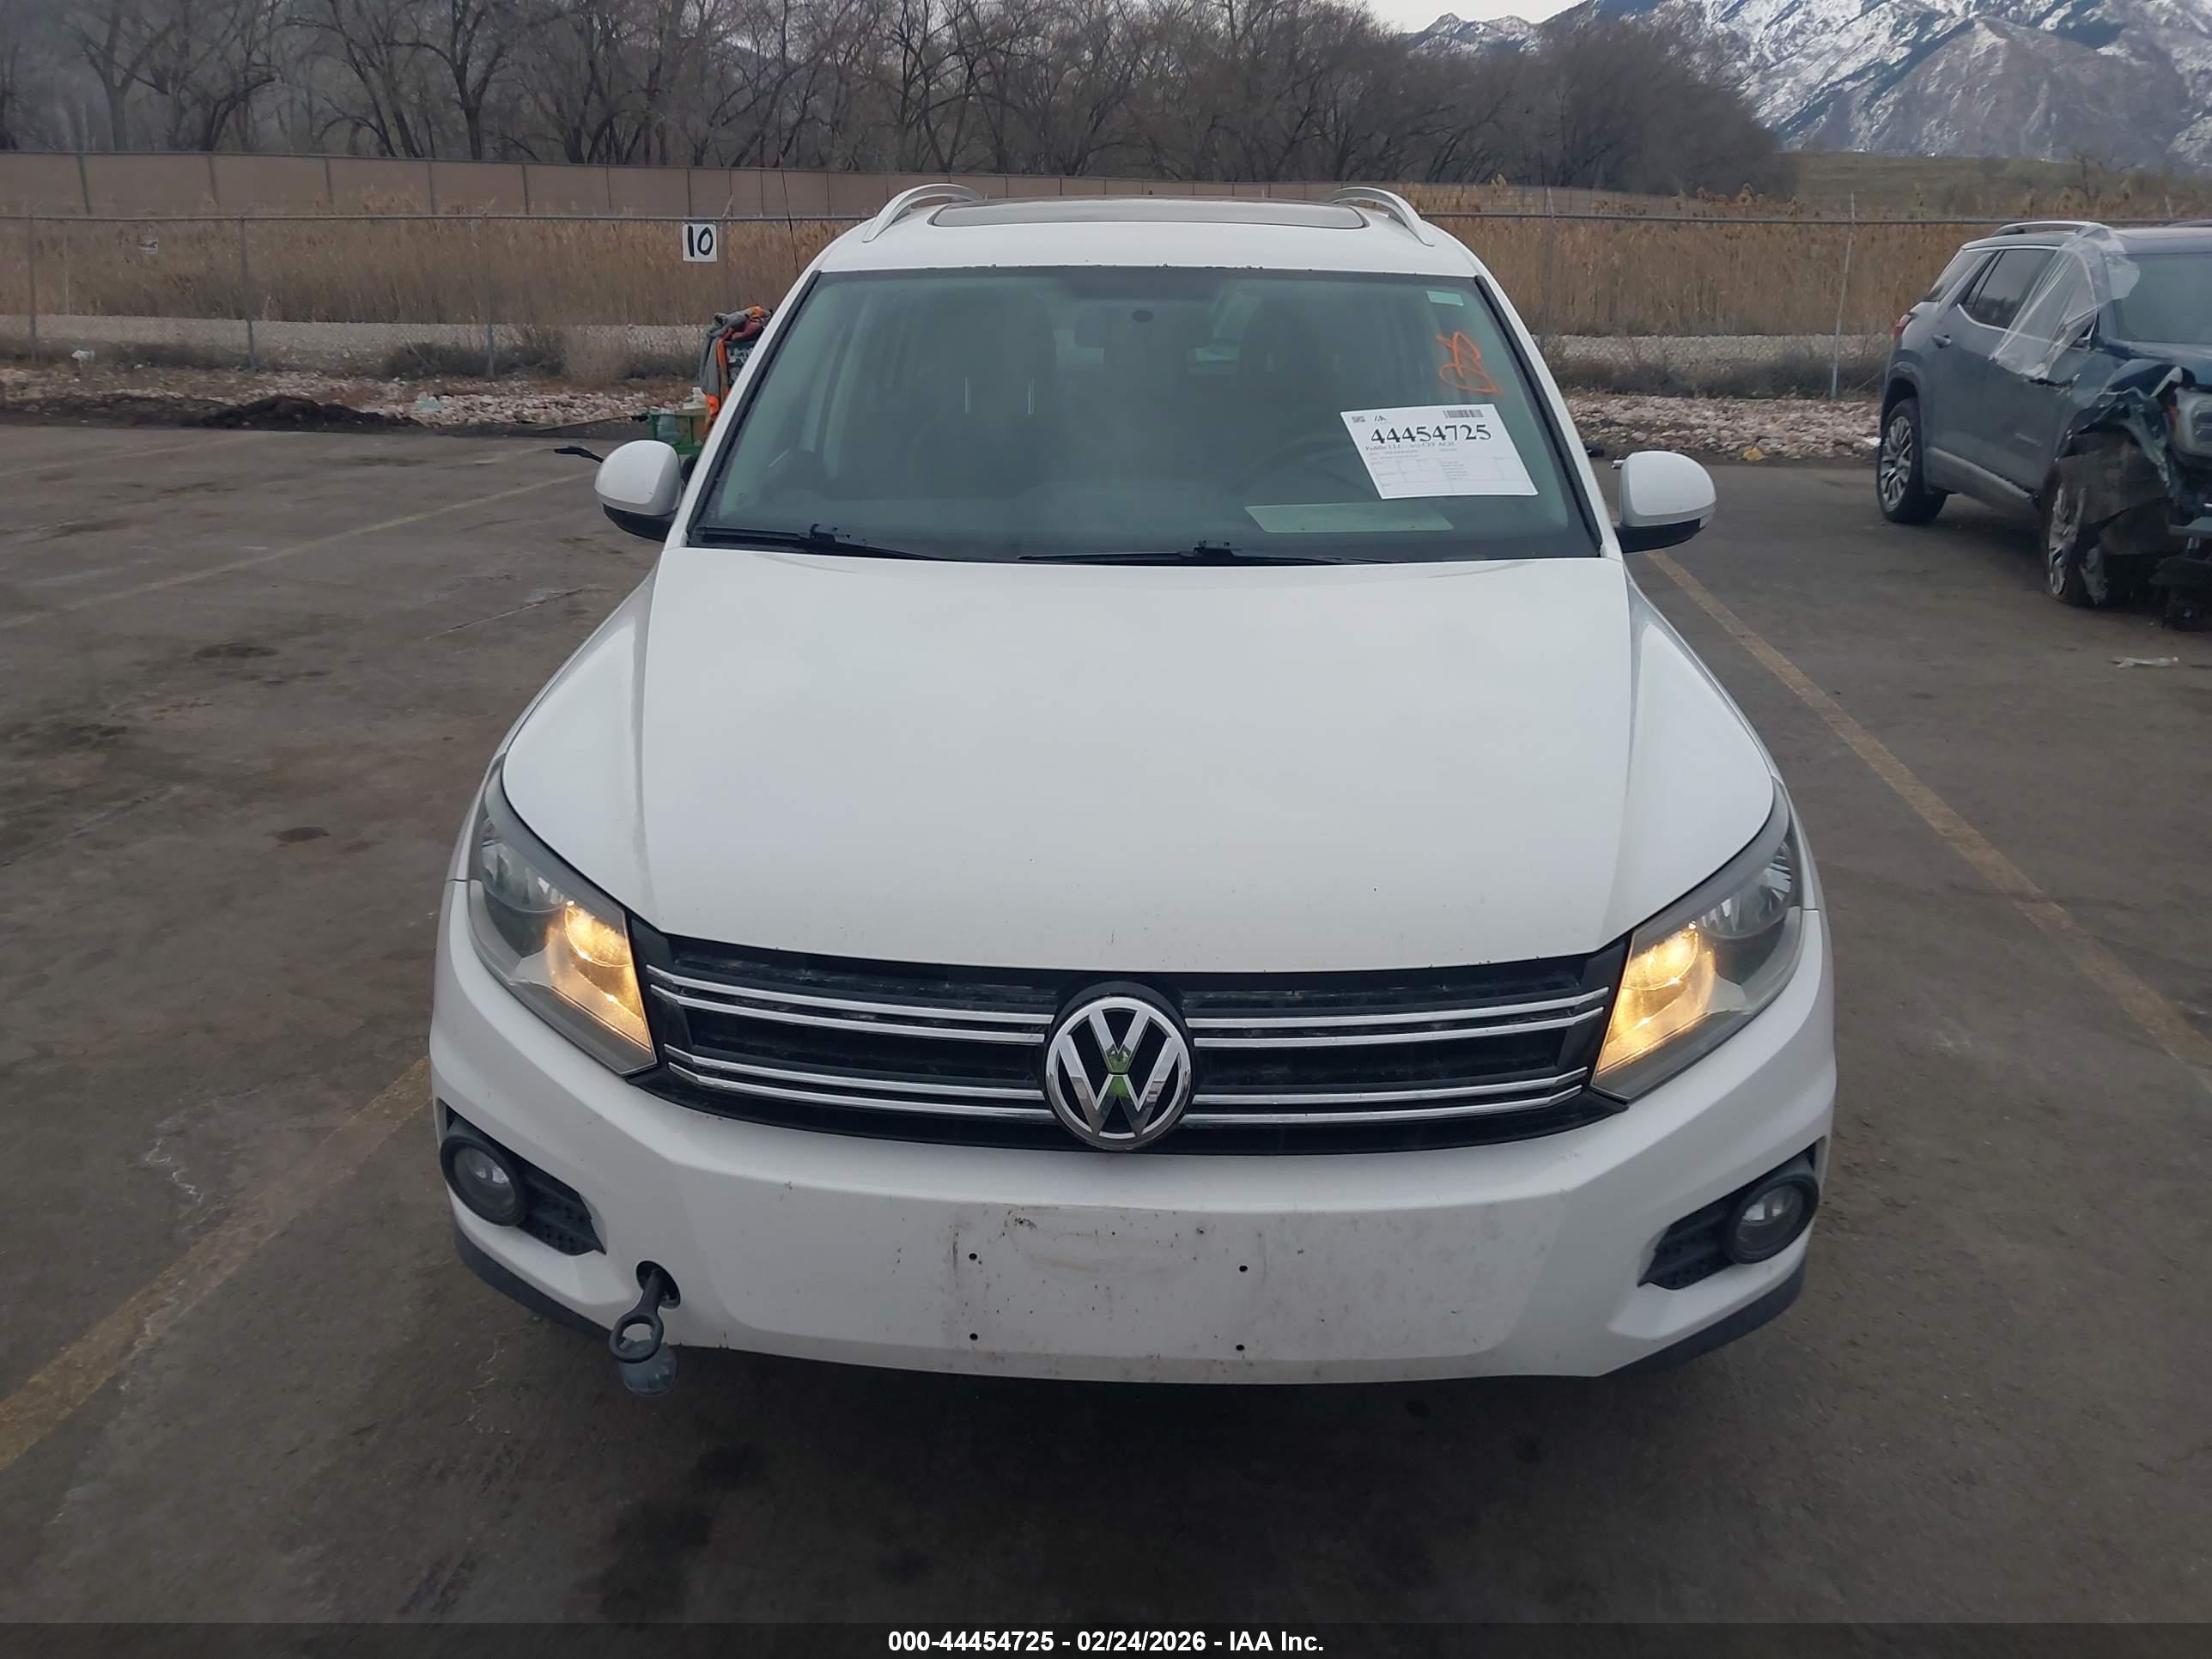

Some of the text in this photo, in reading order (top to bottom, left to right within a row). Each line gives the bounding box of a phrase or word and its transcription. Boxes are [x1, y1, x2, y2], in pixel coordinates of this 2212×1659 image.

[688, 225, 713, 258] 10
[1371, 424, 1492, 444] 44454725
[1051, 1003, 1187, 1142] VW
